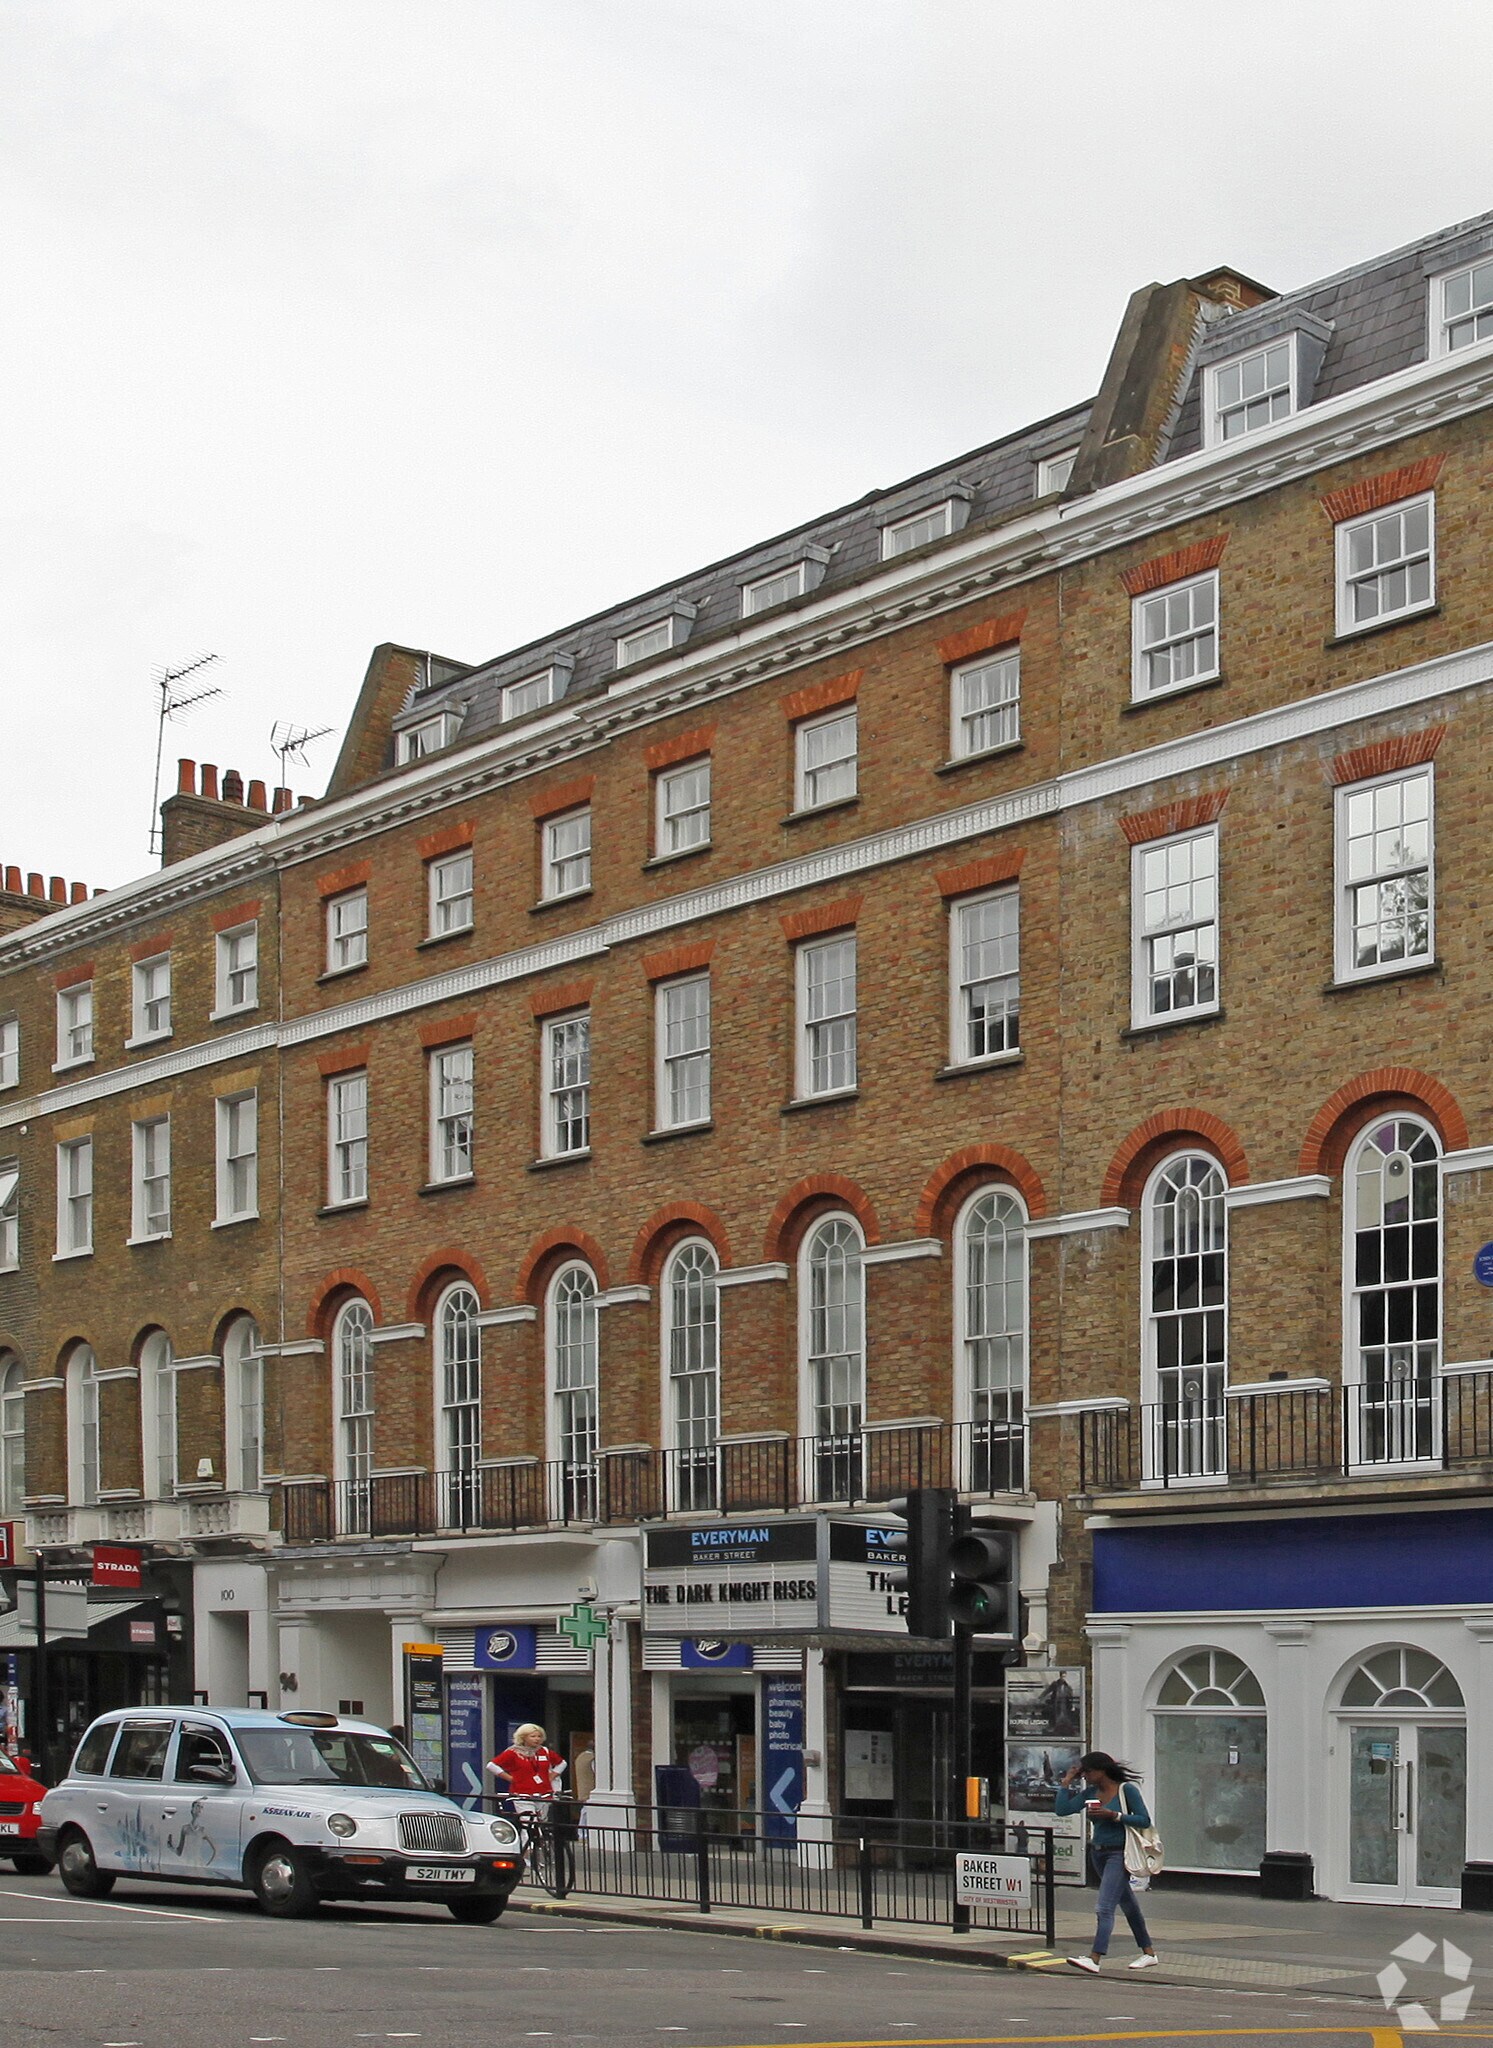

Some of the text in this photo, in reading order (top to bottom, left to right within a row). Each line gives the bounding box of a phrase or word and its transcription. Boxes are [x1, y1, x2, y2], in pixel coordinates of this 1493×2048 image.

[691, 1528, 769, 1546] EVERYMAN
[693, 1550, 756, 1561] BAKER STREET
[867, 1551, 907, 1562] BAKER
[97, 1562, 139, 1573] STRADA
[867, 1571, 895, 1592] TH
[220, 1589, 235, 1601] 100
[644, 1580, 816, 1604] THE DARK KNIGHT RISES
[450, 1681, 483, 1690] welcome
[450, 1699, 479, 1707] pharmacy
[768, 1699, 803, 1709] pharmacy
[450, 1709, 470, 1717] beauty
[768, 1709, 794, 1719] beauty
[450, 1719, 464, 1727] baby
[768, 1719, 786, 1730] baby
[768, 1730, 790, 1740] photo
[450, 1741, 478, 1749] electrical
[769, 1742, 803, 1751] electrical
[293, 1811, 312, 1819] AIR
[963, 1859, 997, 1874] BAKER
[416, 1868, 466, 1880] S211 TMY
[963, 1875, 1022, 1892] STREET W1
[963, 1895, 974, 1903] CITY
[983, 1897, 1018, 1907] WESTMINSTER
